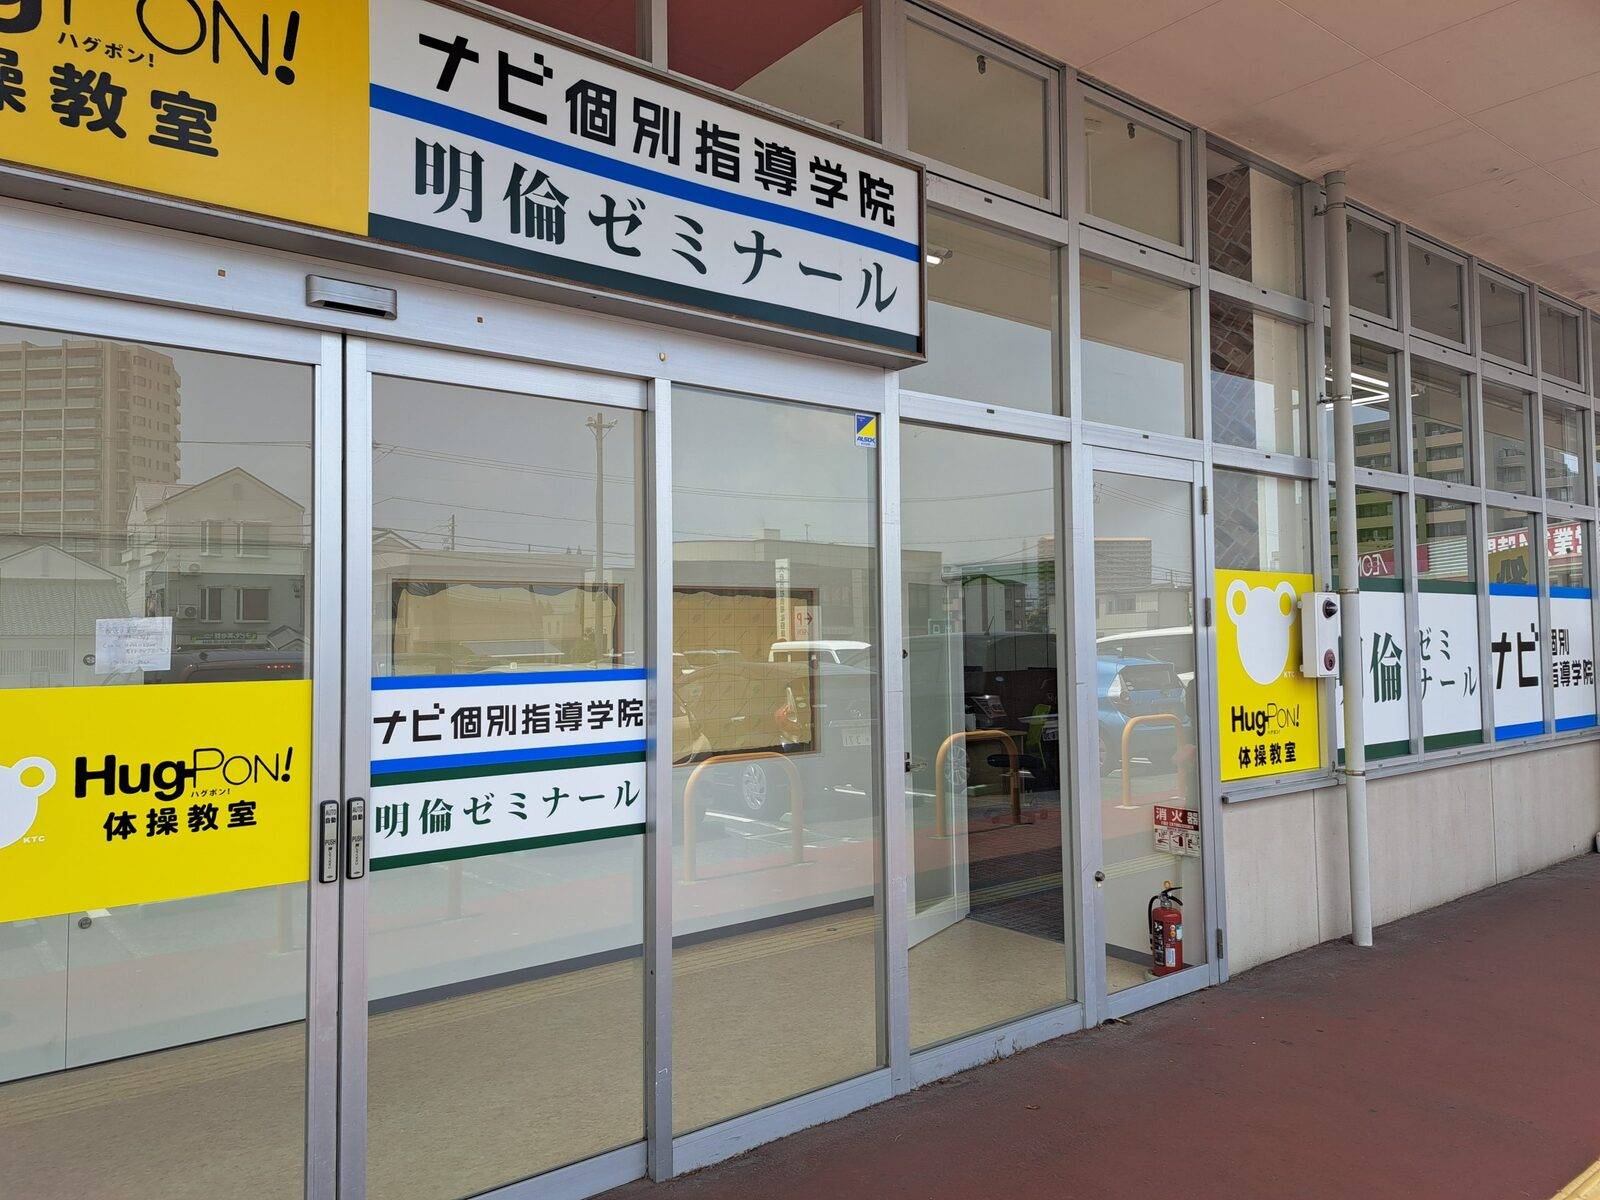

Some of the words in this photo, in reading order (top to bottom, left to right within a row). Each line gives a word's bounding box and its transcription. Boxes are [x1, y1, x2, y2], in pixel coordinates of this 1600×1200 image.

[418, 32, 896, 228] ナビ個別指導学院
[414, 136, 898, 313] 明倫ゼミナール
[1419, 627, 1450, 660] ゼミ
[1491, 622, 1539, 690] ナビ
[373, 698, 644, 745] ナビ個別指導学院
[1238, 741, 1297, 769] 体操教室
[102, 800, 258, 842] 体操教室
[374, 780, 641, 840] 明倫ゼミナール
[1156, 807, 1198, 826] 消火器
[23, 835, 46, 844] KTC
